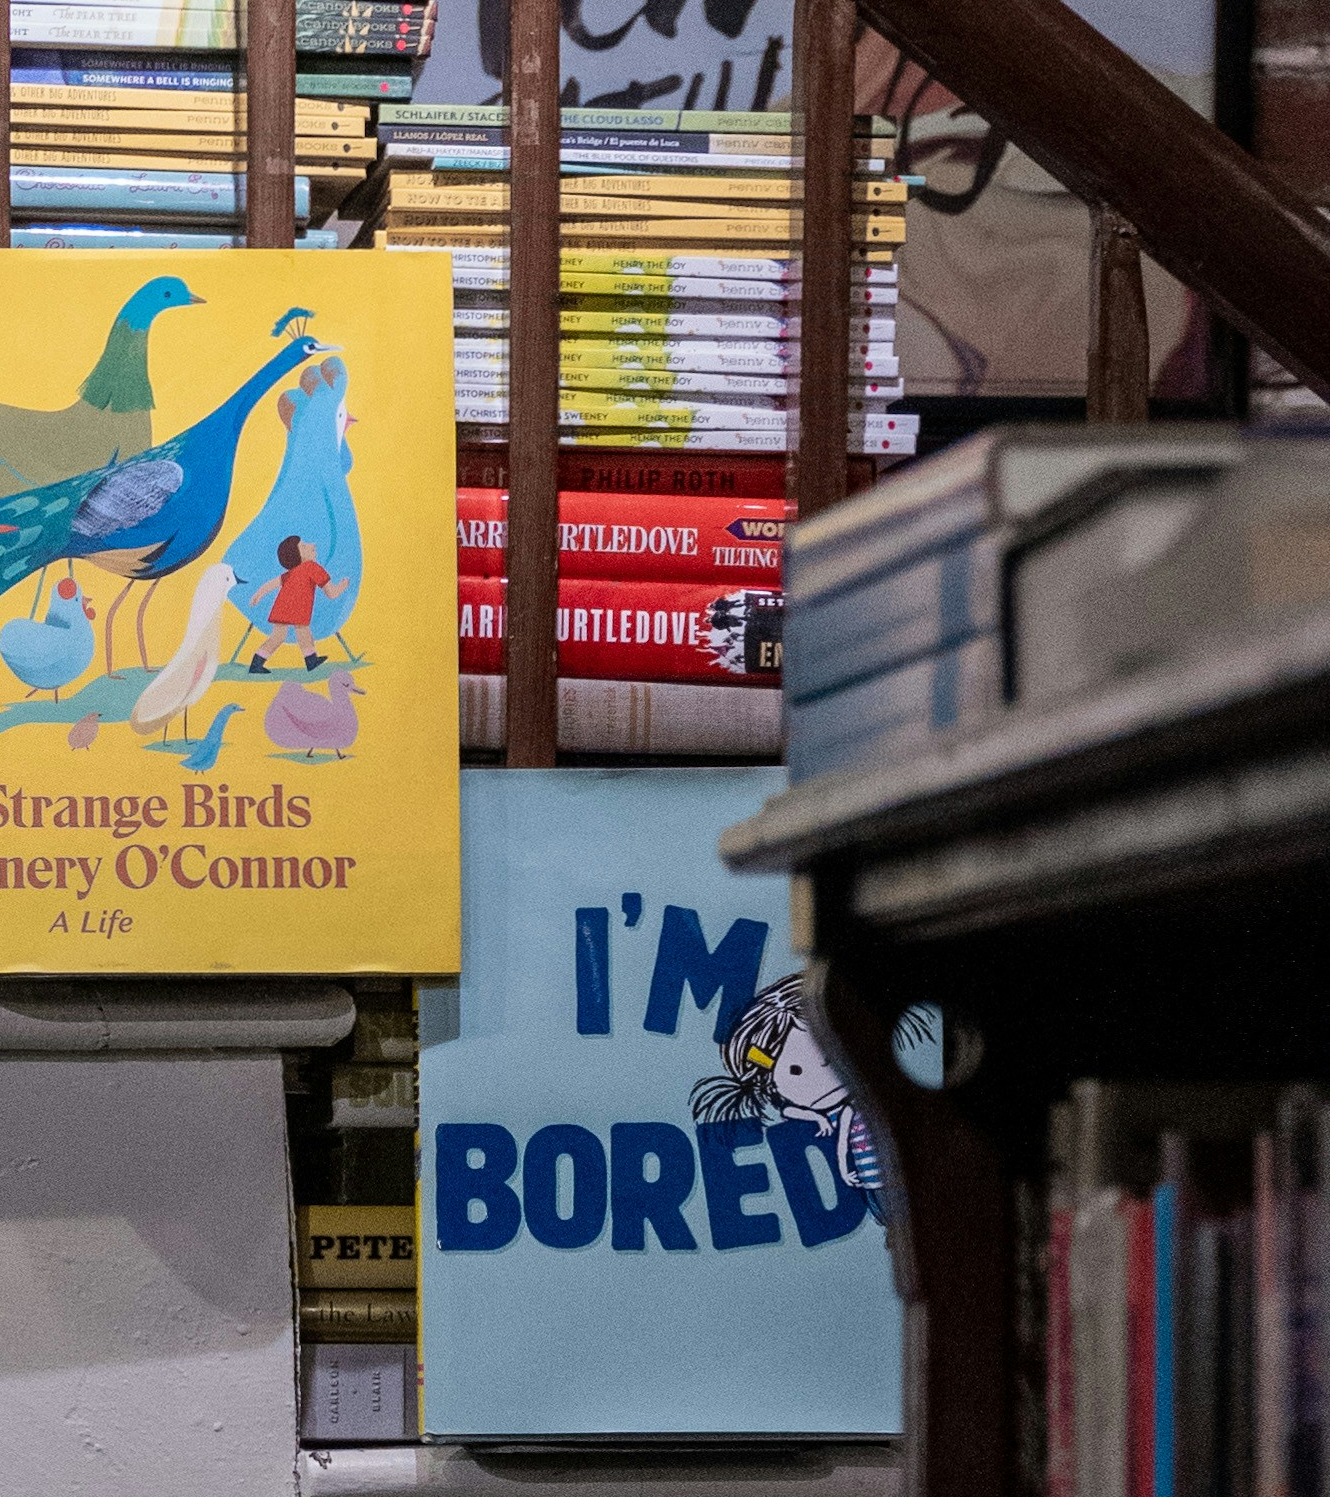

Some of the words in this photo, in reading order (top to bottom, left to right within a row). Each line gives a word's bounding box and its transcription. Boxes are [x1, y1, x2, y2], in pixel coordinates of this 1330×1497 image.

[619, 375, 650, 385] HENRY
[652, 376, 670, 385] THE
[673, 376, 691, 386] BOY
[181, 784, 311, 829] Birds
[116, 843, 357, 891] O'Connor
[49, 911, 70, 933] A
[80, 909, 133, 936] Life
[575, 892, 768, 1044] I'M
[435, 1120, 875, 1252] BORED
